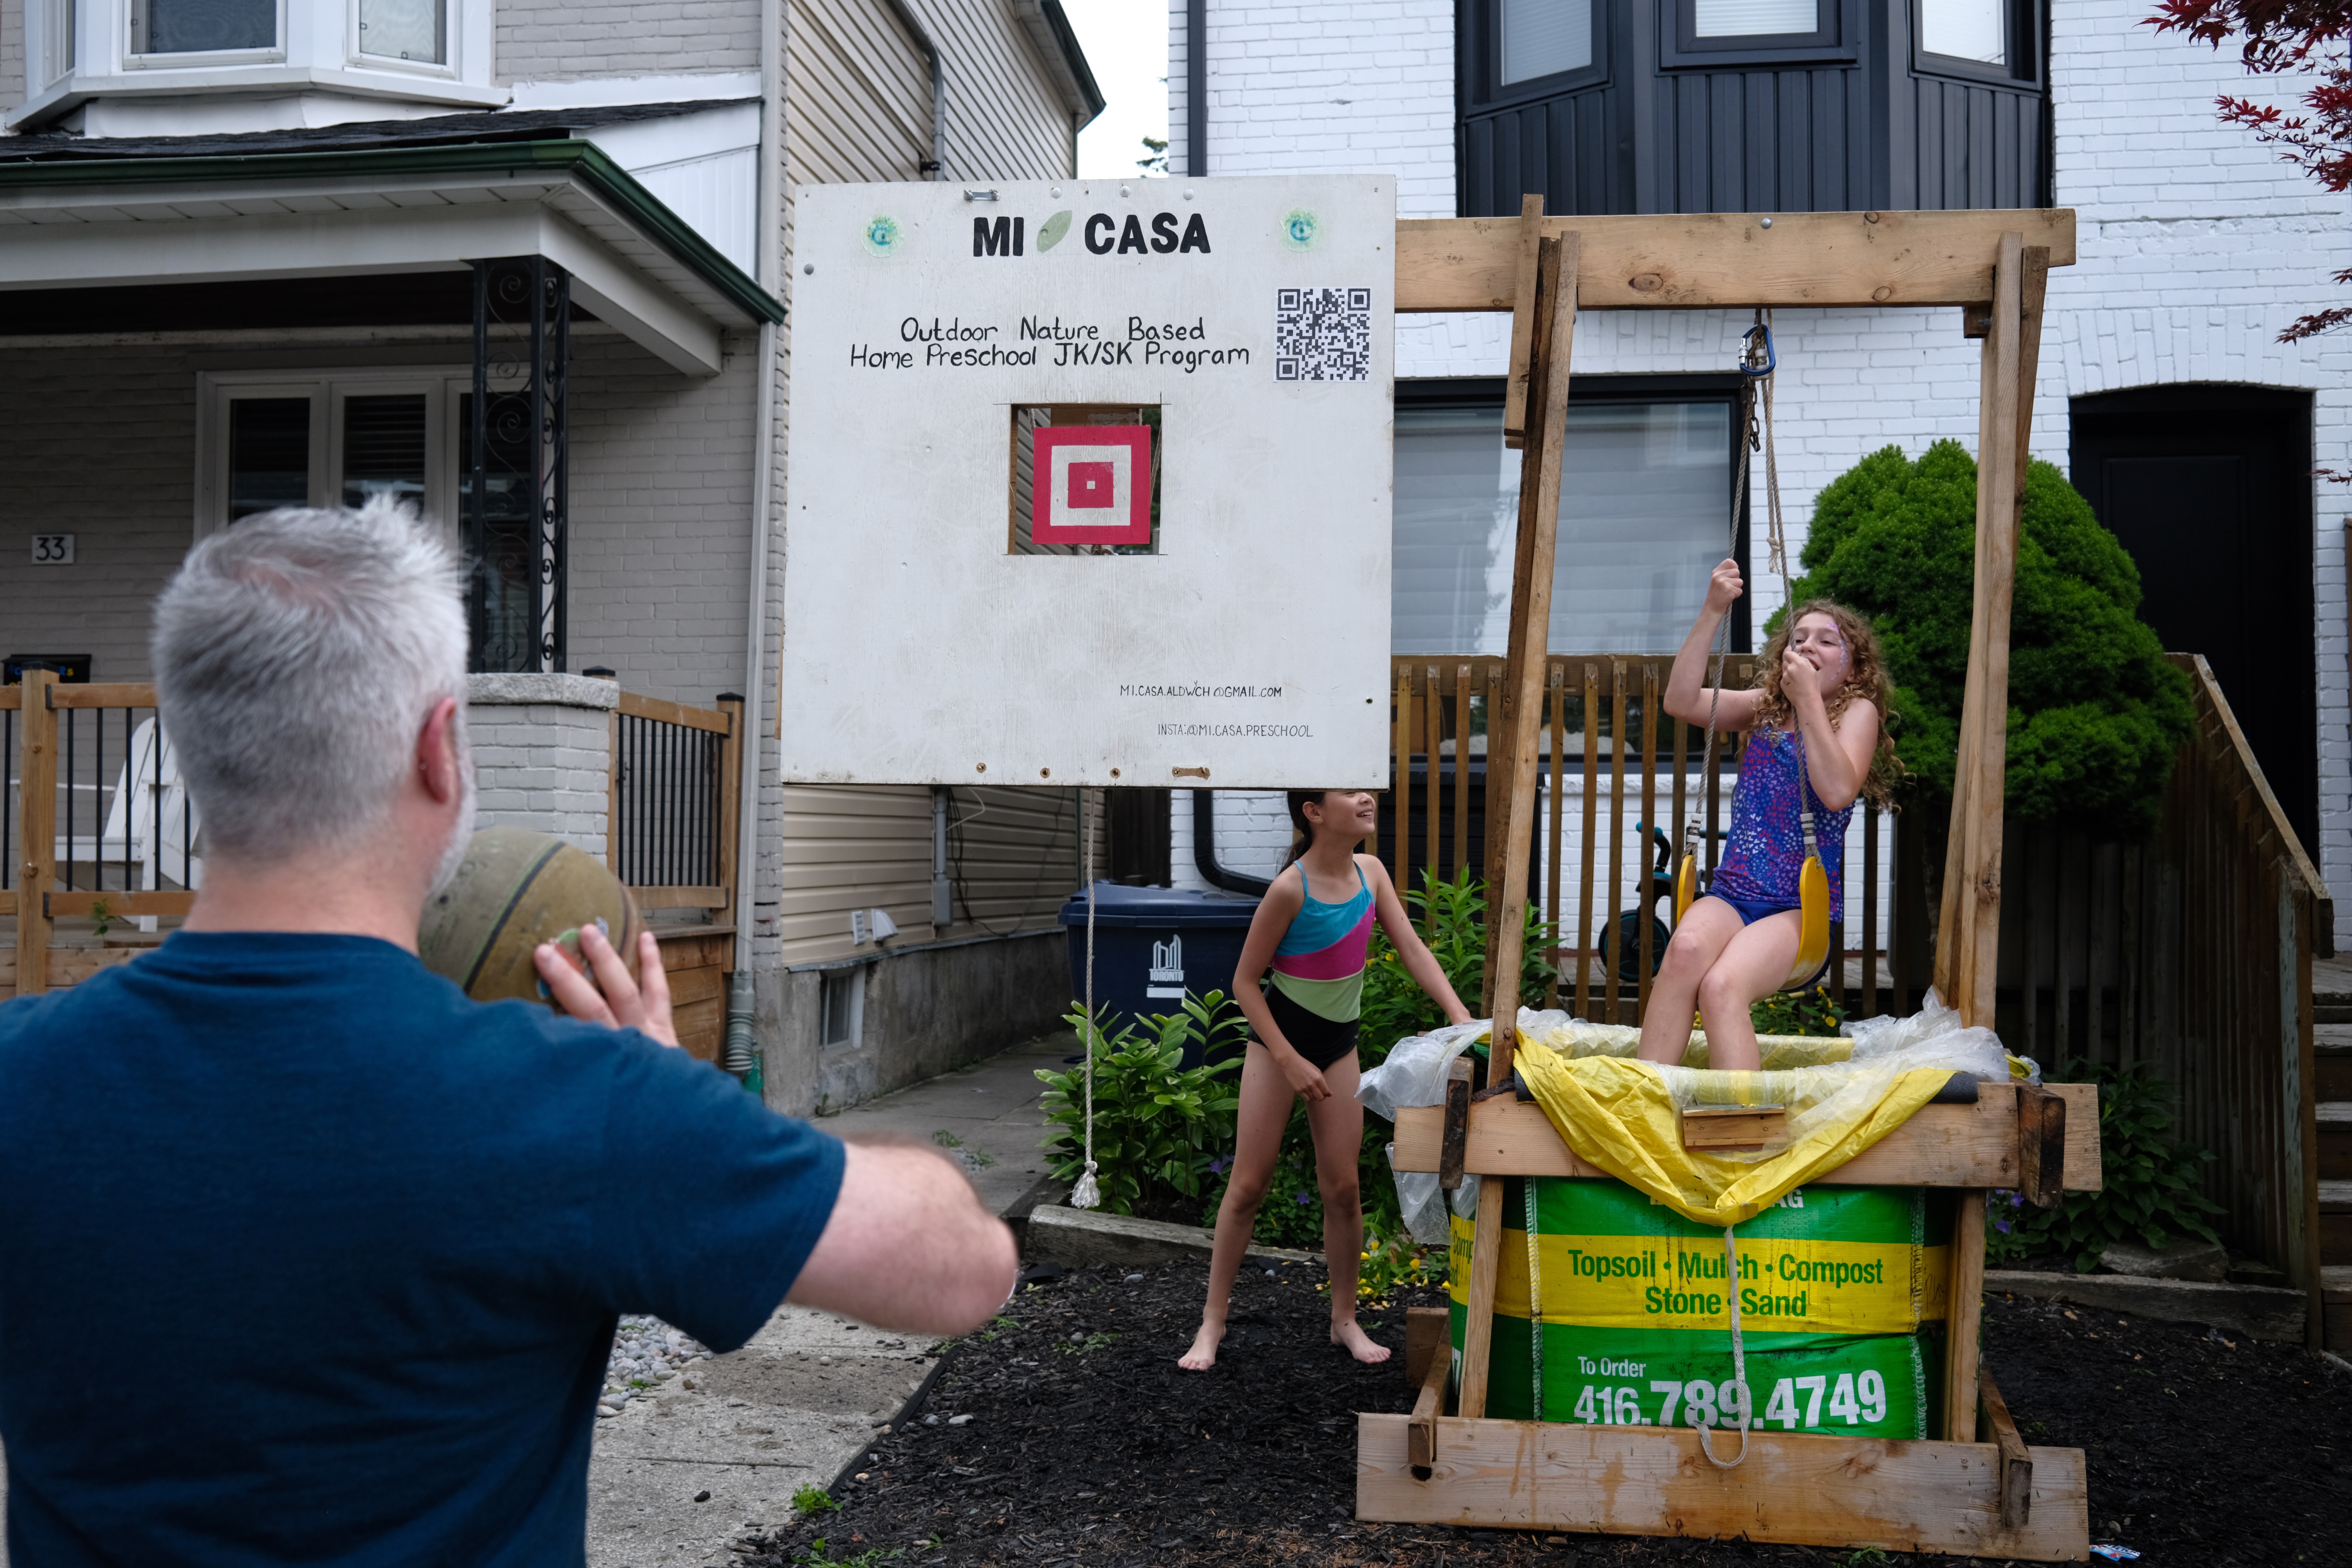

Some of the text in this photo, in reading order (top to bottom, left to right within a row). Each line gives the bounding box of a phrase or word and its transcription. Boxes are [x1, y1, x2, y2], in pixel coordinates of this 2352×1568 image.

[973, 213, 1211, 257] MI CASA
[901, 315, 1205, 342] Outdoor Nature Based
[851, 341, 1249, 374] Home Preschool JK/SK Program
[36, 537, 64, 561] 33
[1149, 969, 1185, 982] TORONTO
[1568, 1250, 1655, 1282] Topsoil
[1779, 1254, 1883, 1288] Compost
[1646, 1286, 1806, 1317] Stone Sand
[1578, 1356, 1646, 1378] To Order
[1574, 1369, 1886, 1429] 416.789.4749
